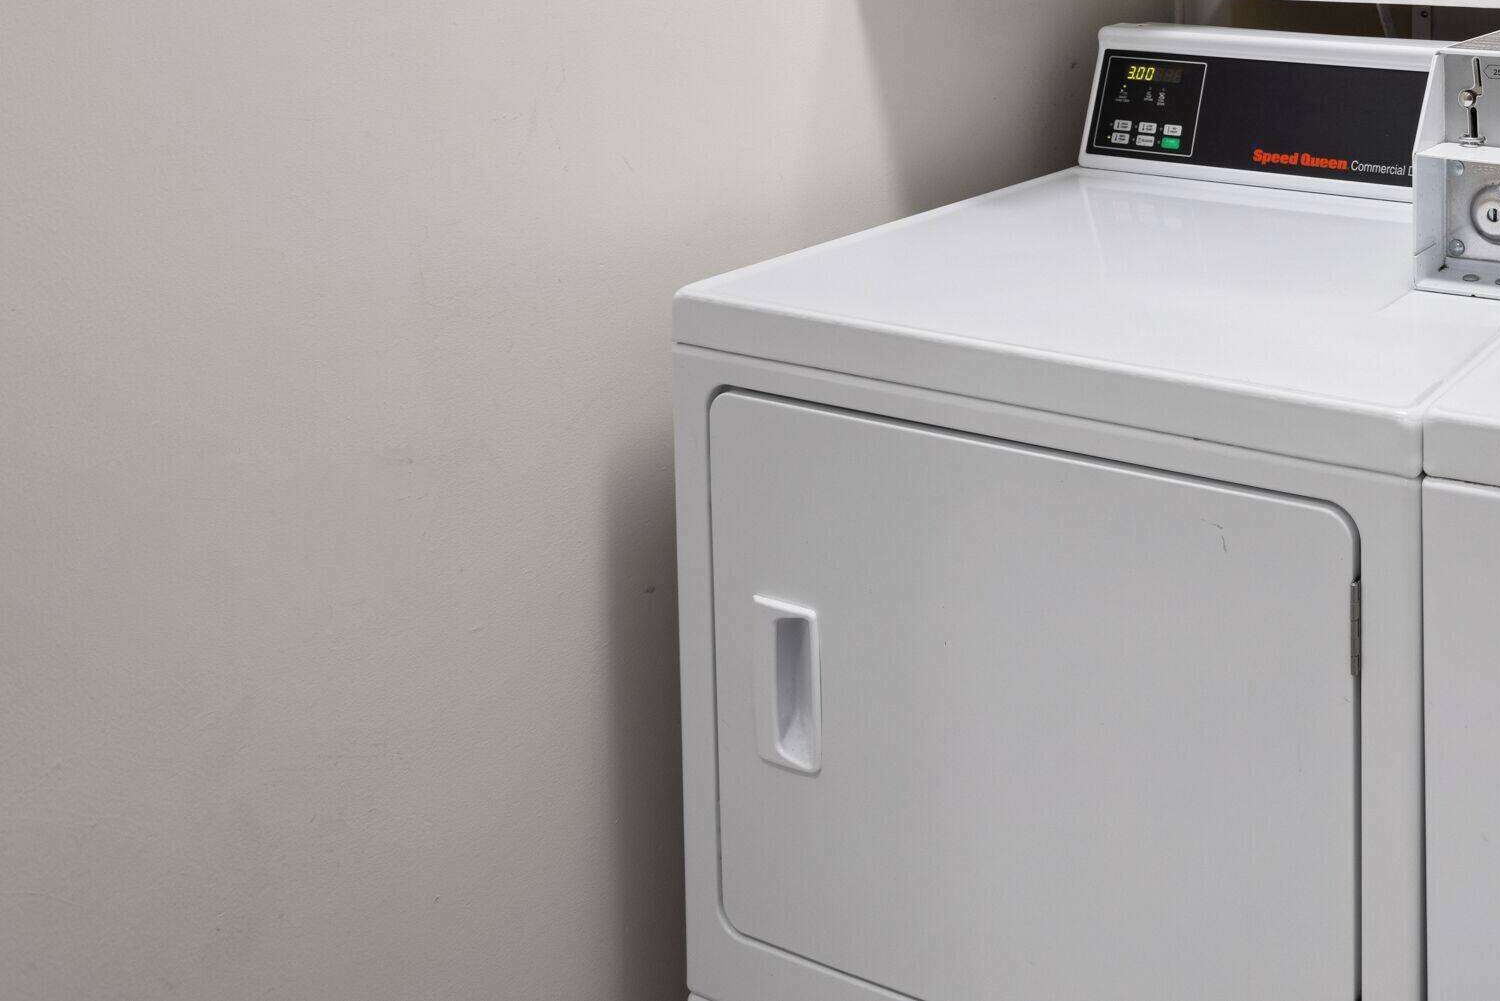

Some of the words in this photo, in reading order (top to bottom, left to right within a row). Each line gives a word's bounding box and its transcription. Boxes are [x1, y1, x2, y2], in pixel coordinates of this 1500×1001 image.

[1126, 65, 1155, 81] 3.00
[1252, 148, 1299, 165] Speed
[1300, 152, 1348, 170] Queen
[1350, 159, 1406, 176] Commercial
